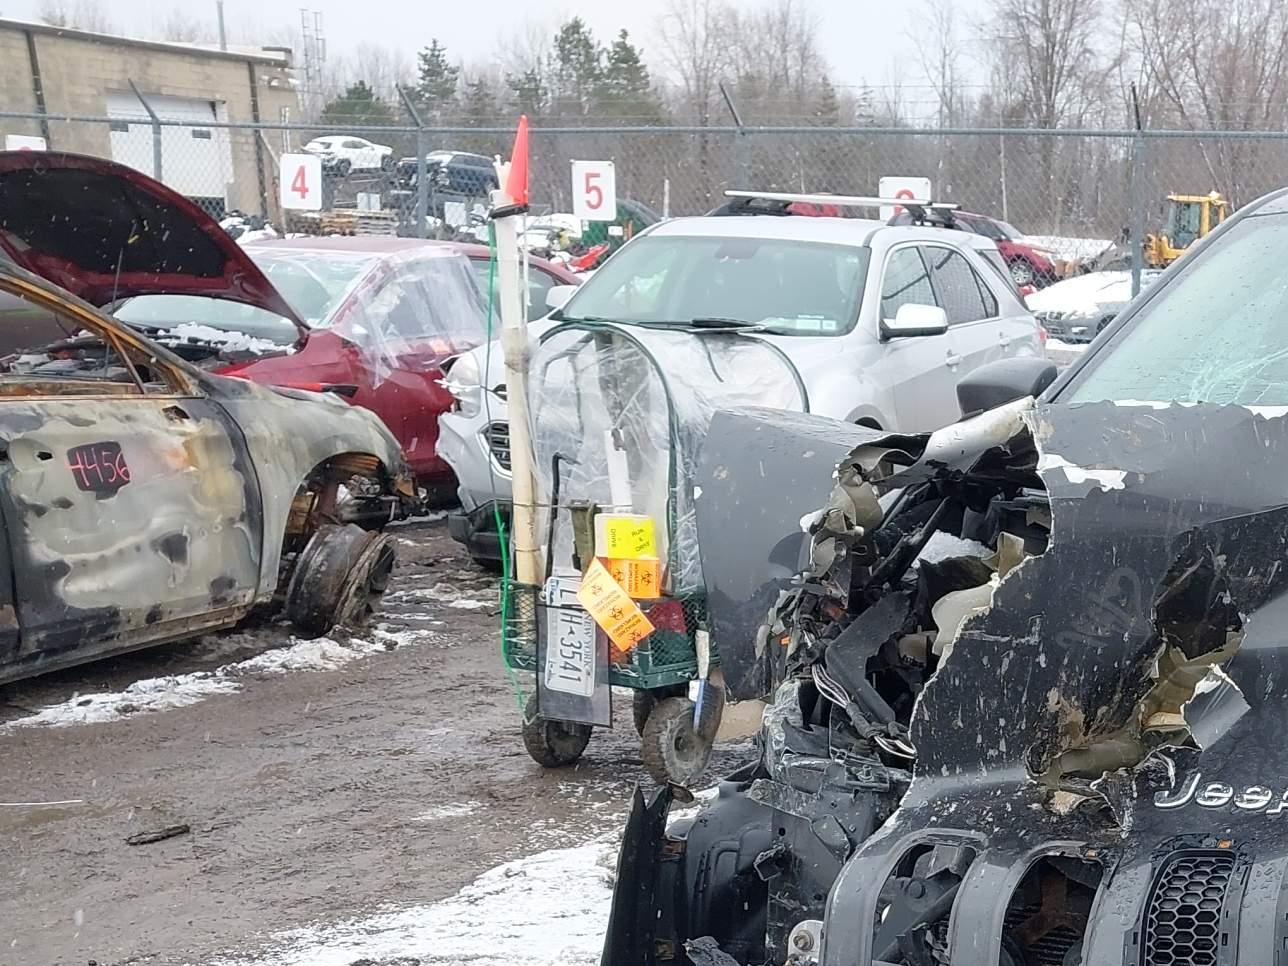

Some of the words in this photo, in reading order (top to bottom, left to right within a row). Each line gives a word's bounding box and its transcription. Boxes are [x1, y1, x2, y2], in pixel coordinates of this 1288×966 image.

[290, 165, 310, 199] 4
[584, 172, 604, 210] 5
[583, 612, 592, 638] NEW
[583, 639, 592, 668] YORK
